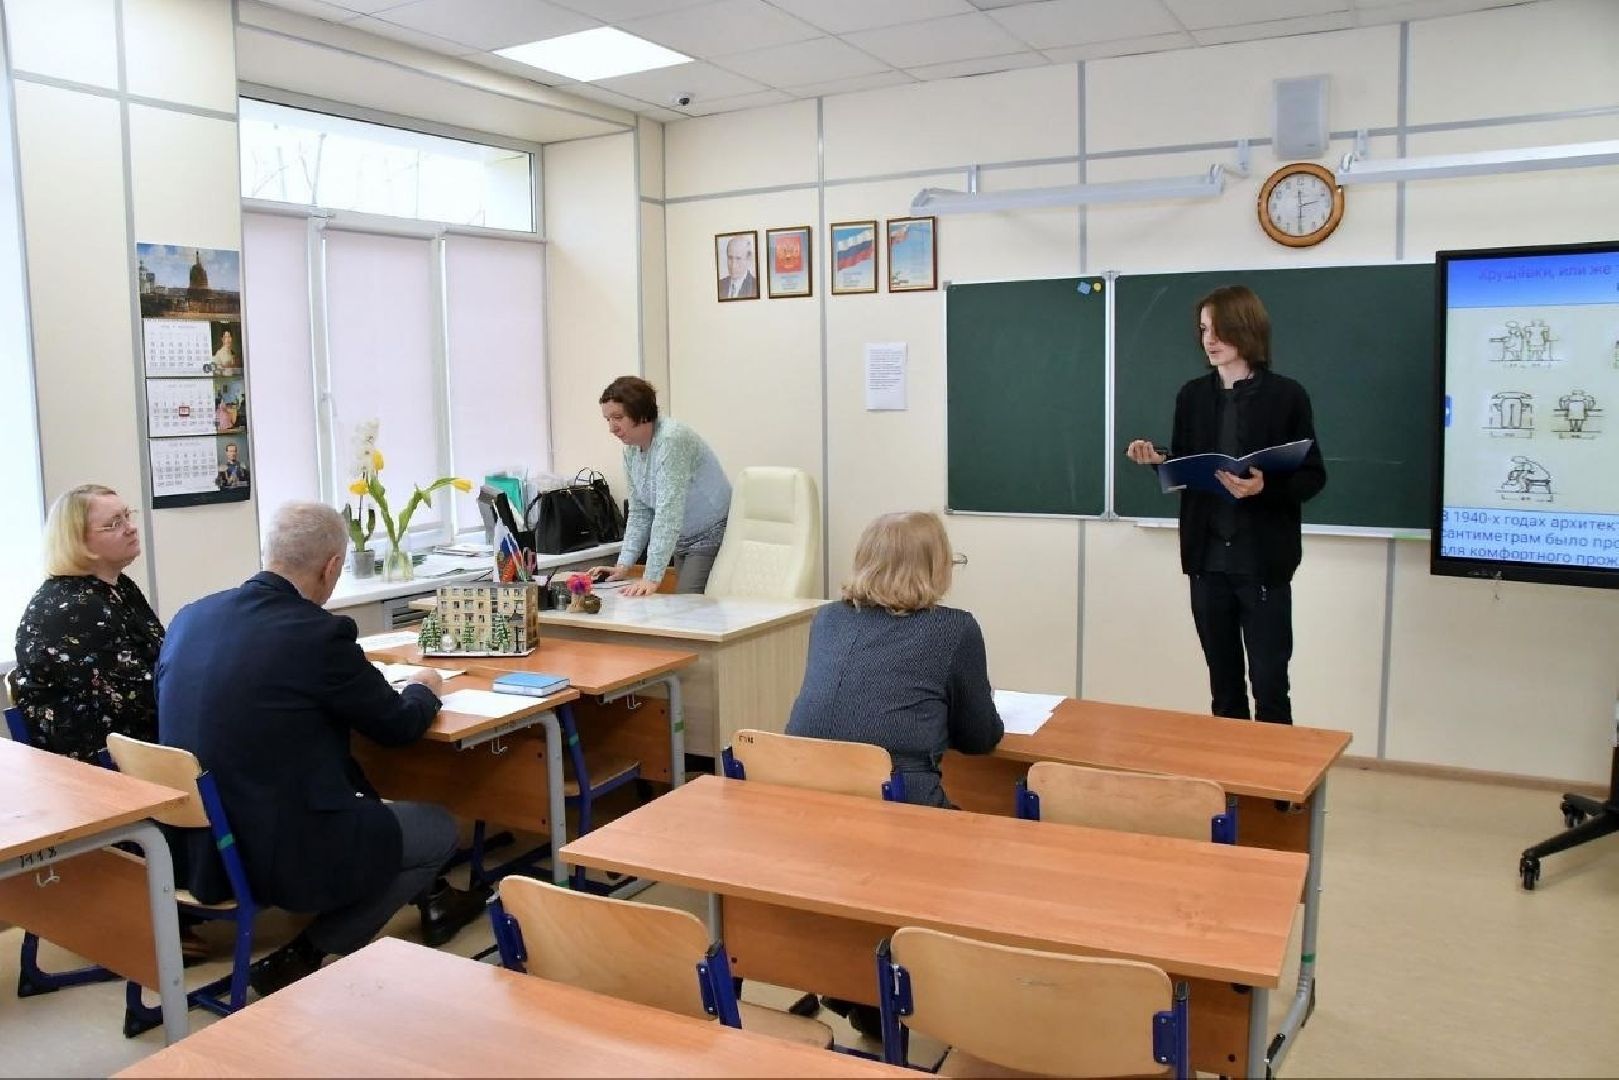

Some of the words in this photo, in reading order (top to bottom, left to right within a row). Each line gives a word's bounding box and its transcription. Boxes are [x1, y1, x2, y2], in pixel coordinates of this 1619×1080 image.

[1454, 511, 1500, 524] 1940-х
[1505, 516, 1546, 529] годах
[1551, 518, 1619, 531] архитек
[1545, 533, 1588, 546] было
[1471, 546, 1572, 563] комфортного
